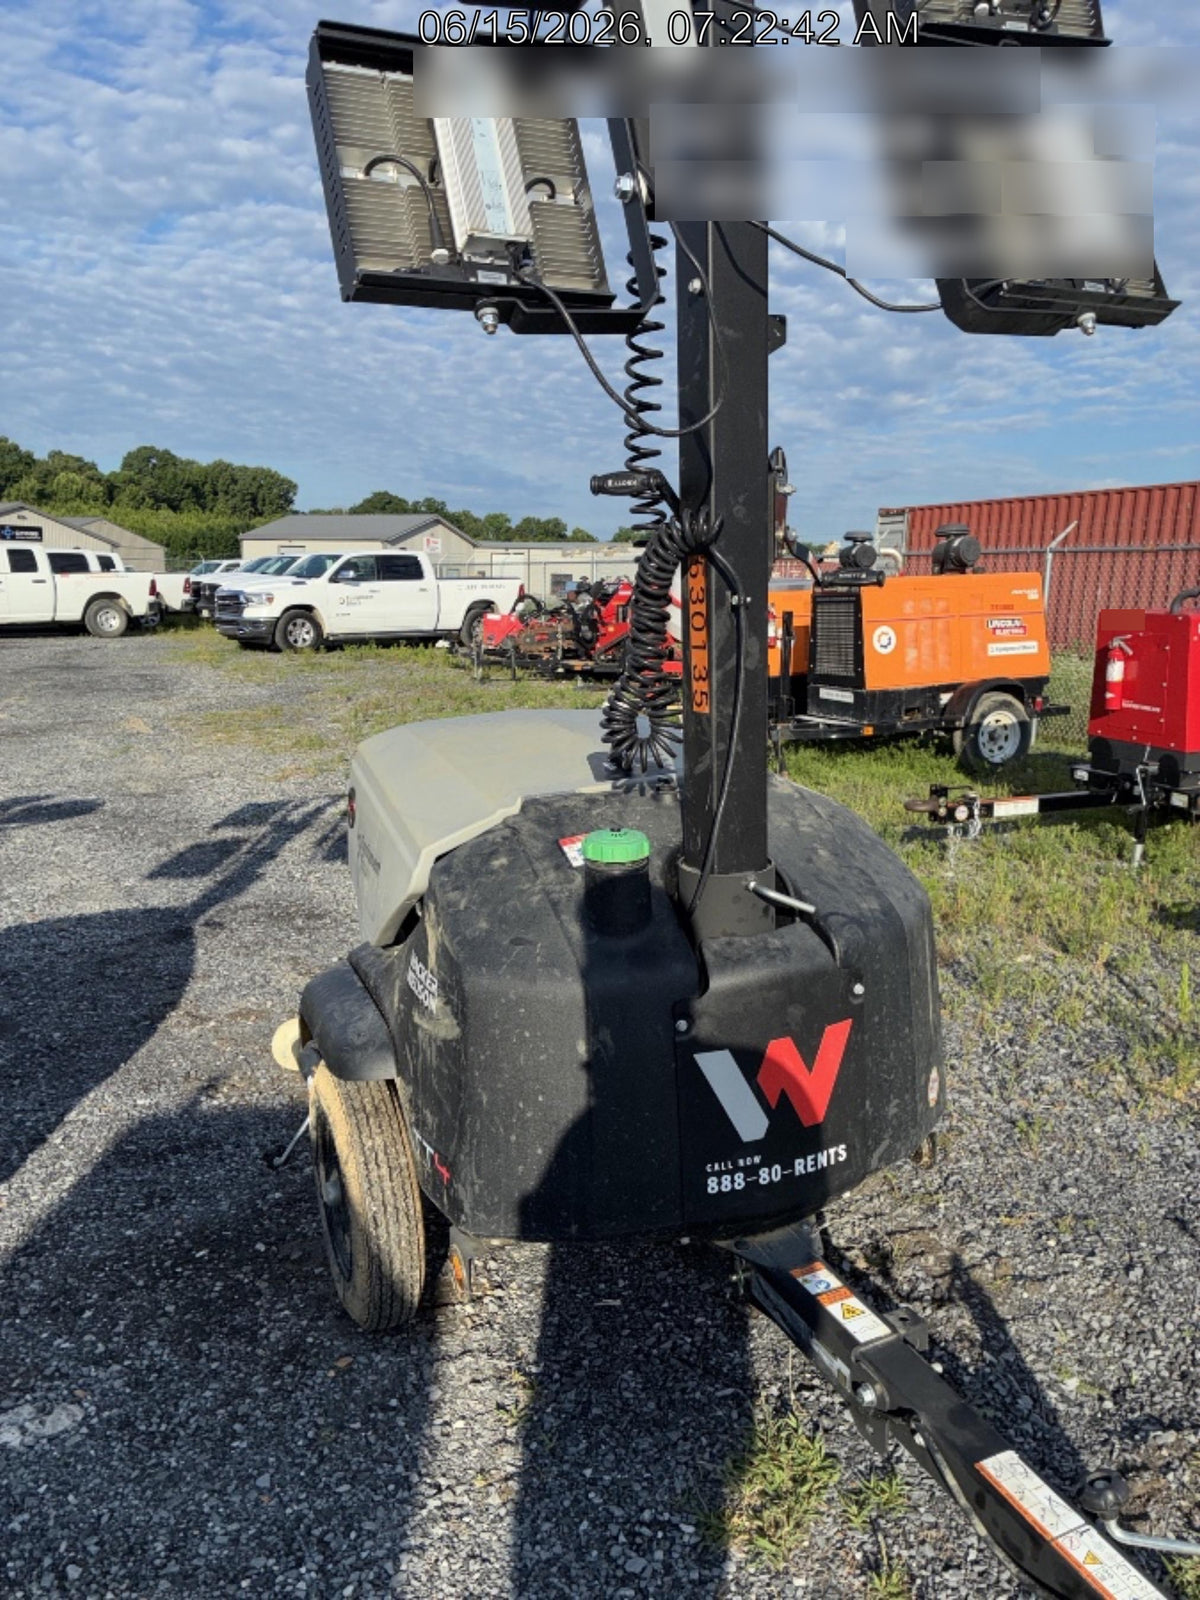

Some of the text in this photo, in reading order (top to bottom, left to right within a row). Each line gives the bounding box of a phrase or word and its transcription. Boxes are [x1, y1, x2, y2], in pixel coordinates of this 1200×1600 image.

[705, 1155, 762, 1172] CALL NOW
[706, 1143, 848, 1194] 888-80-RENTS
